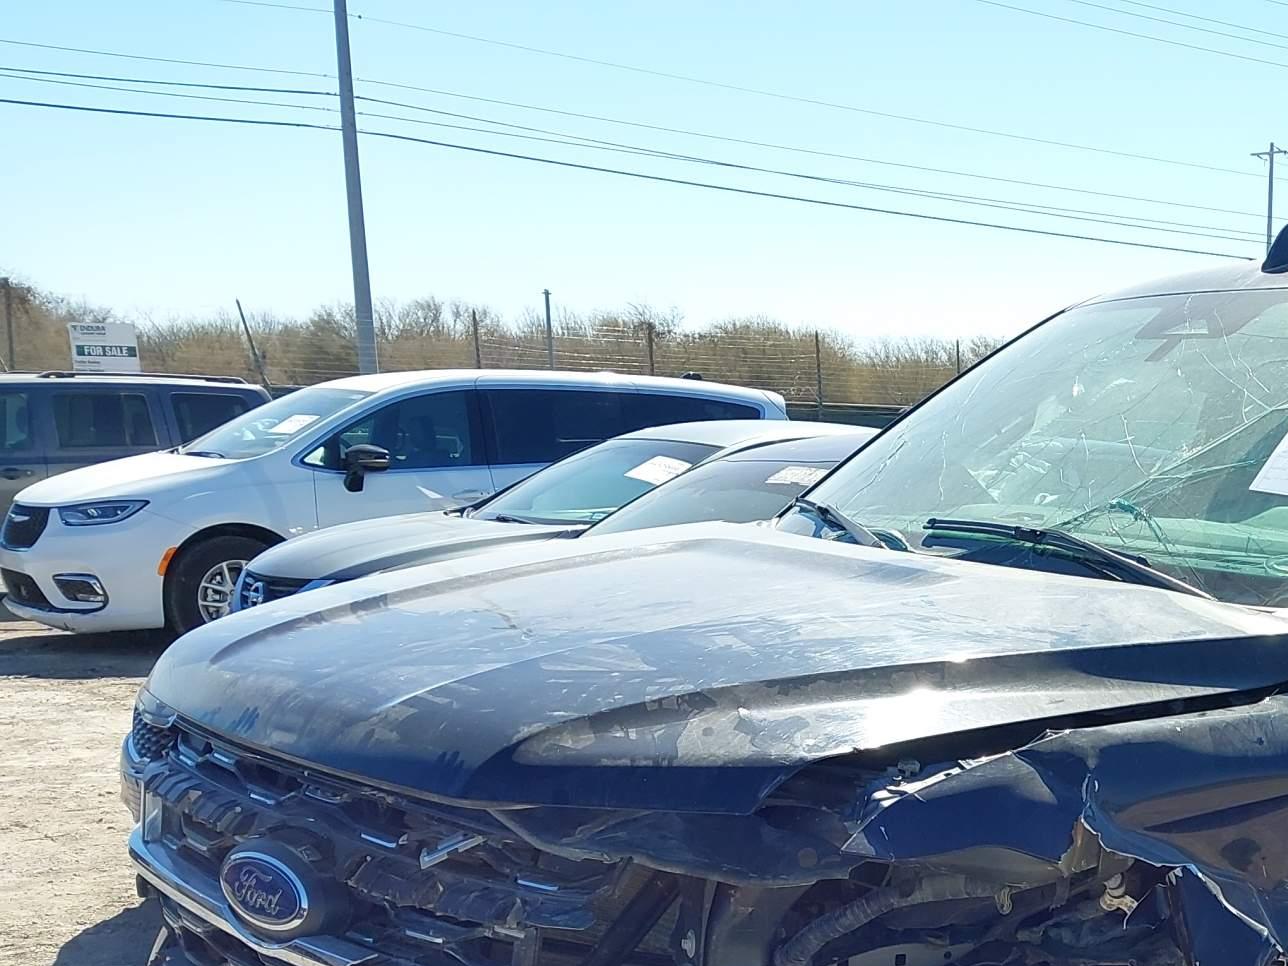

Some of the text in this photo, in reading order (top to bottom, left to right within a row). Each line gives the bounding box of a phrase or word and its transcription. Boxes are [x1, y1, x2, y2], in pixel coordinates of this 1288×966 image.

[84, 346, 128, 356] FOR SALE
[234, 865, 283, 915] Ford
